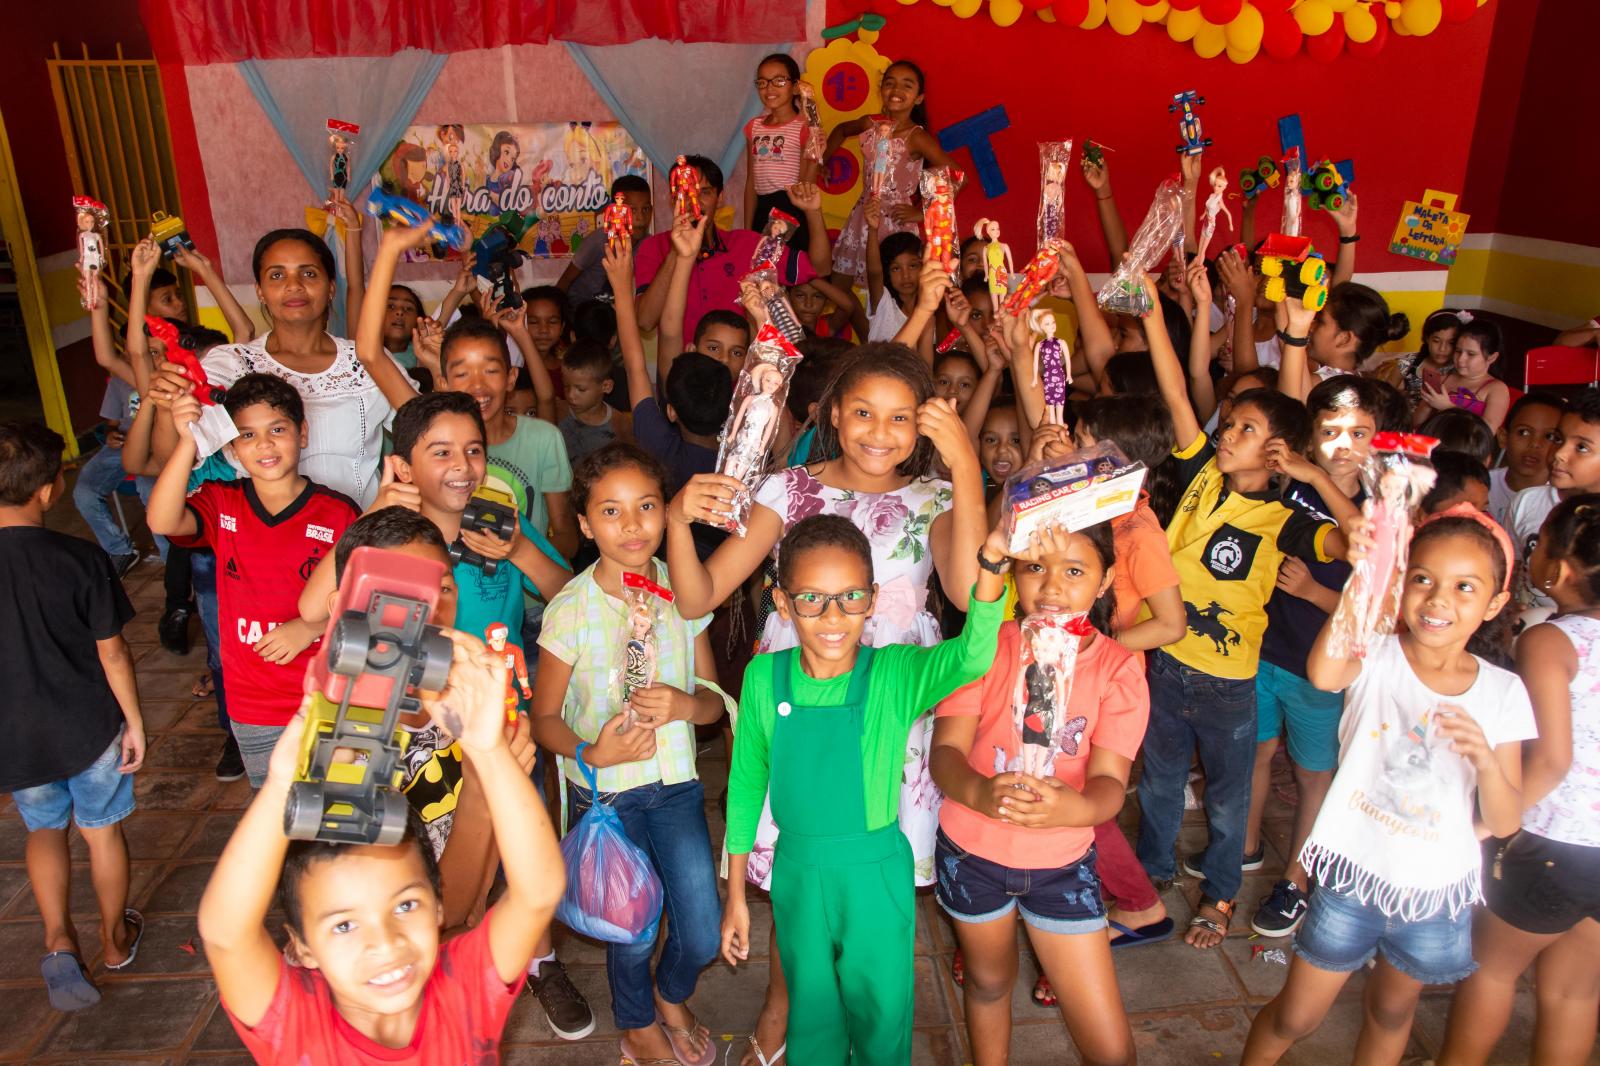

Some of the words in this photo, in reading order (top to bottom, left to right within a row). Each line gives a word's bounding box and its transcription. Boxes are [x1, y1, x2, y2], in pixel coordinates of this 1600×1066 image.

[500, 168, 533, 213] do
[542, 170, 608, 213] conto
[1414, 206, 1449, 224] MALETA
[1409, 229, 1445, 245] LEITURA
[1019, 494, 1052, 510] RACING
[305, 528, 335, 544] BRASIL
[1349, 789, 1440, 841] Bunnycorn
